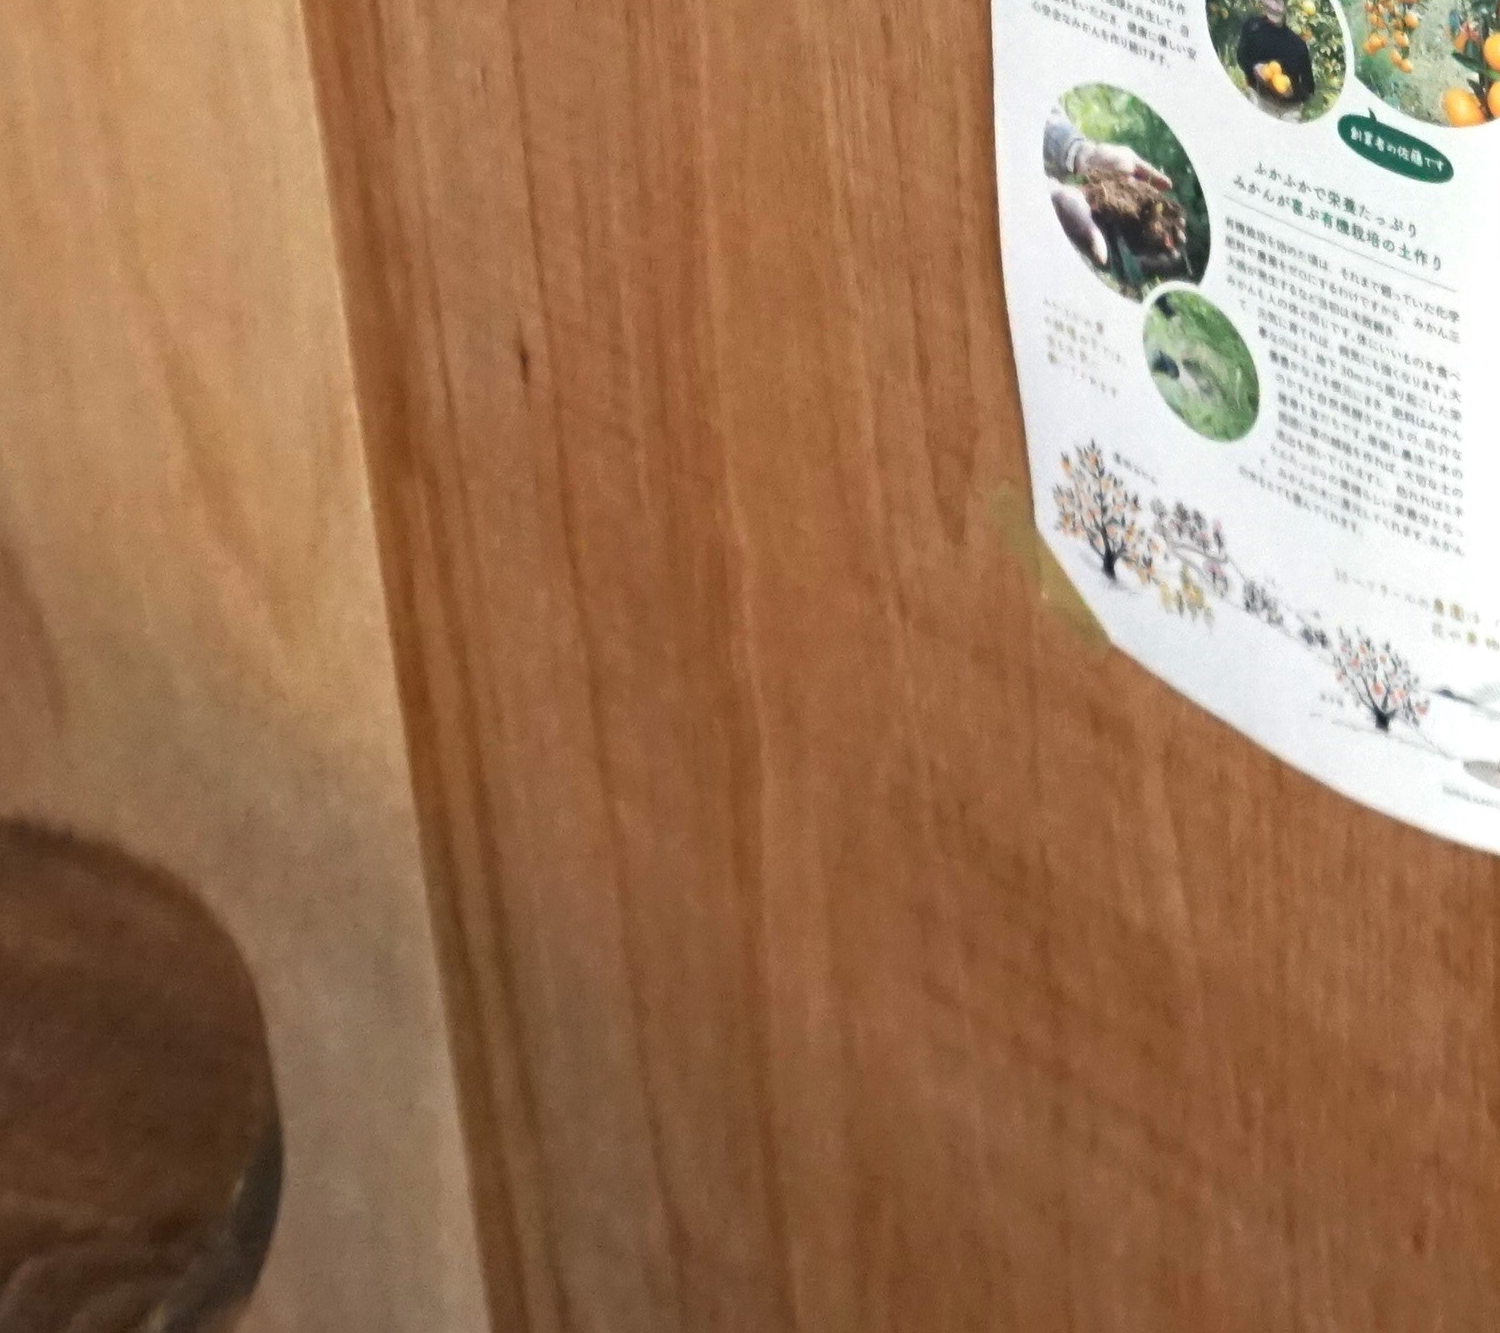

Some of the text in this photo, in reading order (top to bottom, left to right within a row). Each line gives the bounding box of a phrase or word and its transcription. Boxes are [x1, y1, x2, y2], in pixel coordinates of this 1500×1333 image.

[1254, 160, 1417, 238] ふかふかで栄養たっぷり
